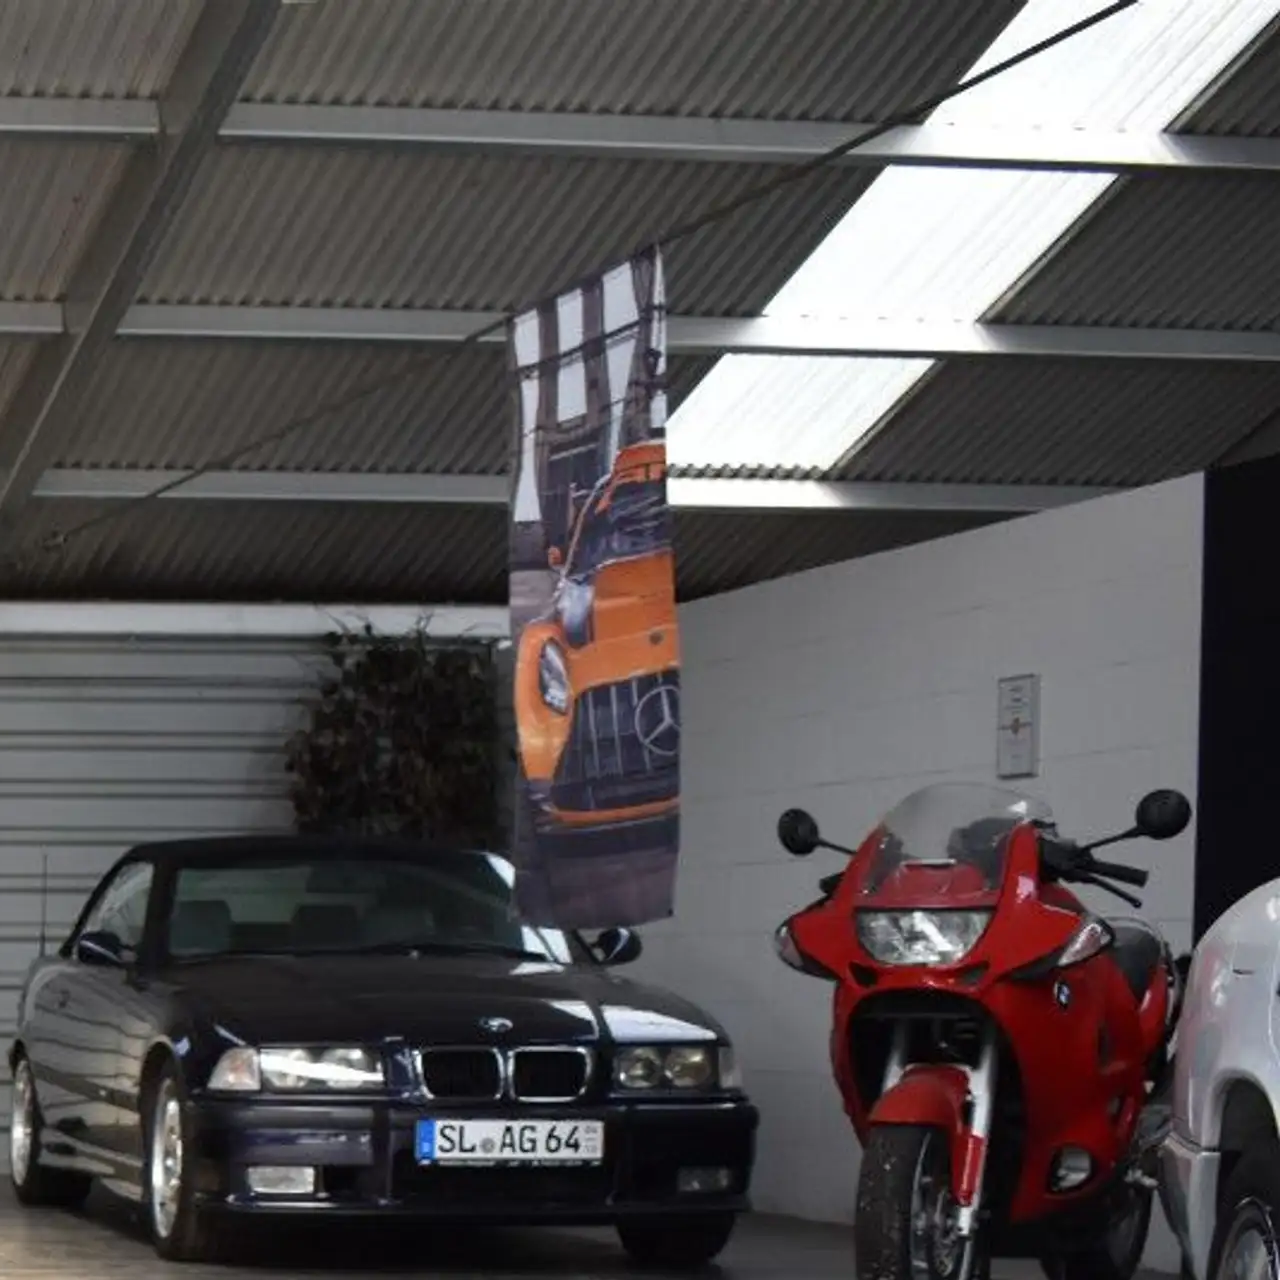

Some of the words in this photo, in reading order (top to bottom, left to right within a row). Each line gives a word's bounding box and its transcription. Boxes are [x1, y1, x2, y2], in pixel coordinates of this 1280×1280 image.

[438, 1124, 476, 1153] SL
[500, 1125, 538, 1153] AG
[545, 1125, 579, 1153] 64
